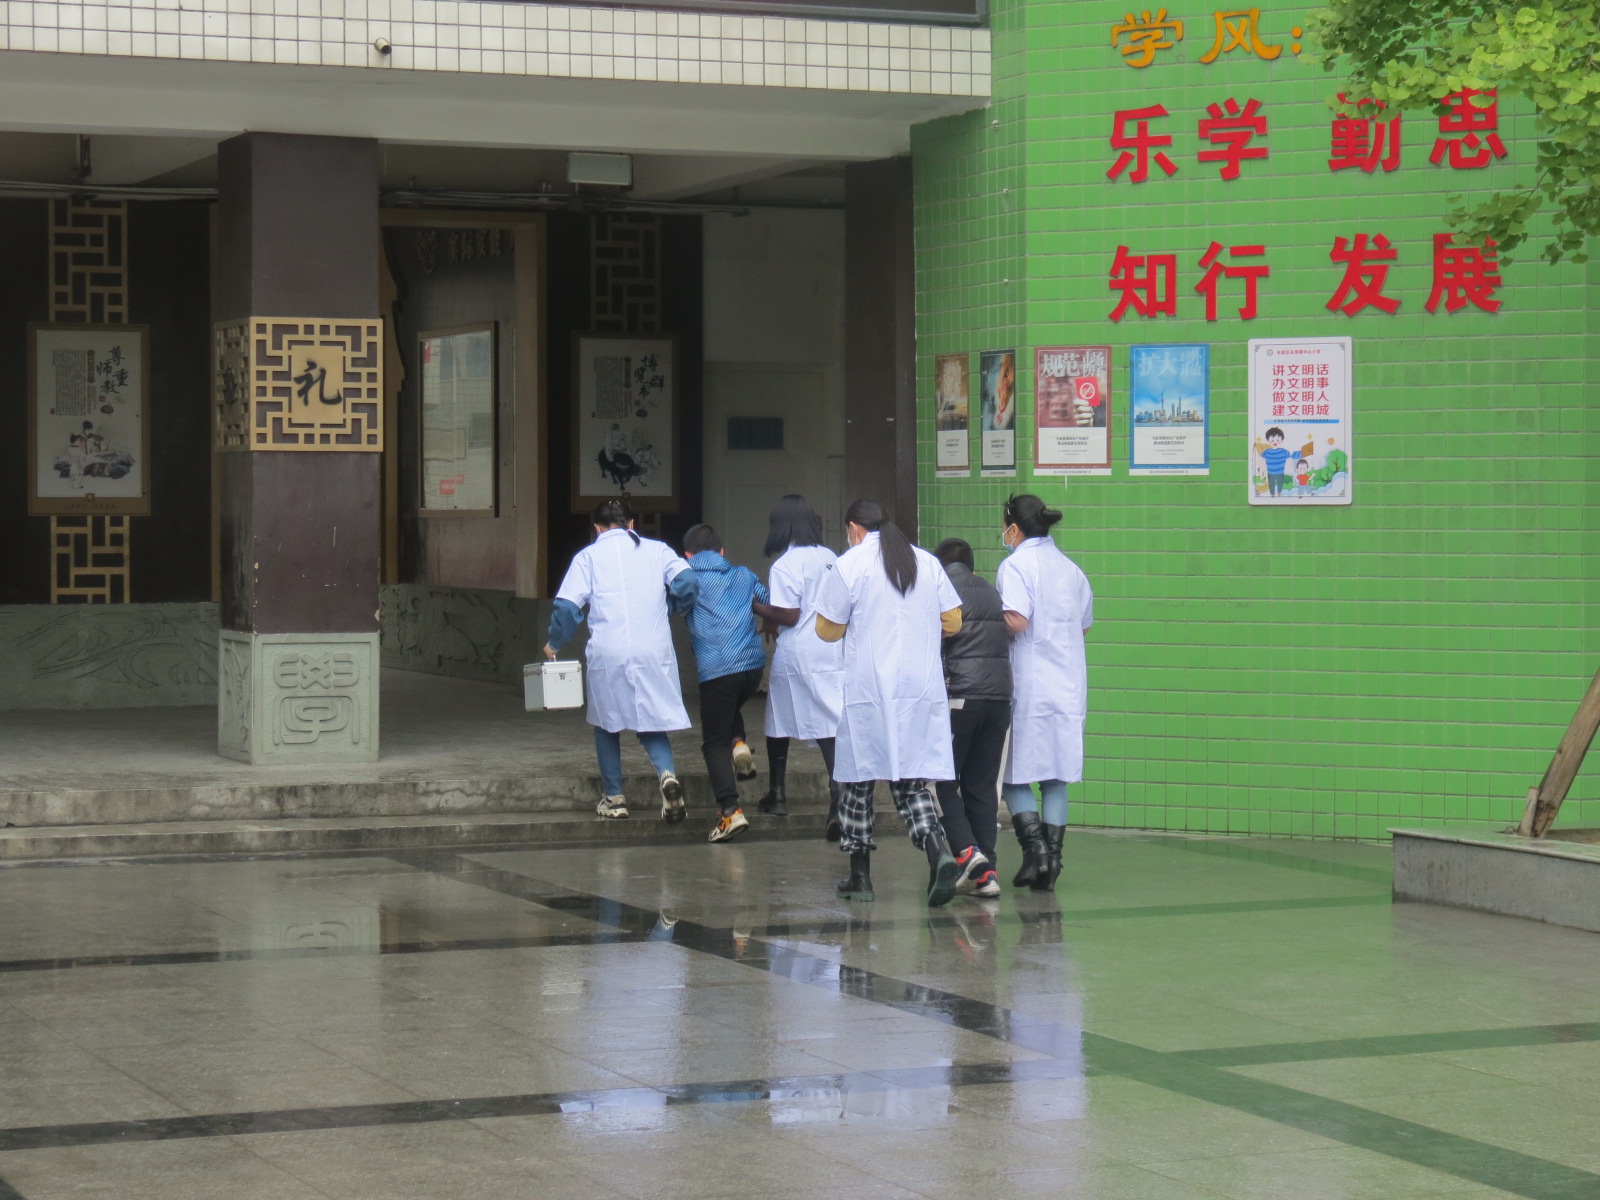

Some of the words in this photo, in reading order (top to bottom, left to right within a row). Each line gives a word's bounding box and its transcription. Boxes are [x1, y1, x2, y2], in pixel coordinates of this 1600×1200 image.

[1107, 98, 1269, 184] 乐学
[1327, 87, 1508, 175] 勤思
[1107, 241, 1270, 323] 知行
[1326, 233, 1504, 317] 发展
[1272, 363, 1329, 376] 讲文明话
[293, 358, 342, 406] 礼
[1272, 377, 1329, 390] 办文明事
[1272, 391, 1329, 403] 做文明人
[1272, 404, 1329, 417] 建文明城
